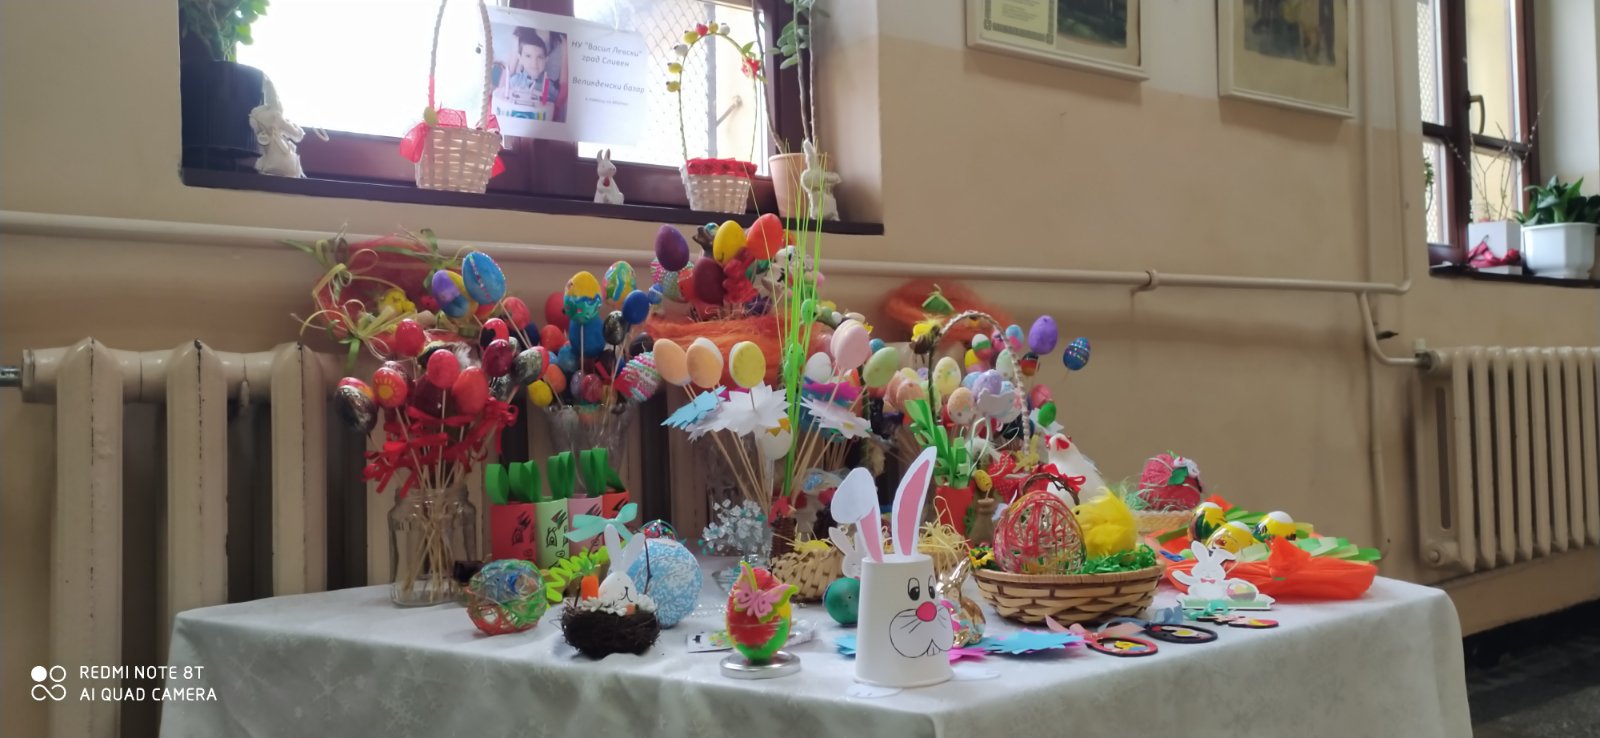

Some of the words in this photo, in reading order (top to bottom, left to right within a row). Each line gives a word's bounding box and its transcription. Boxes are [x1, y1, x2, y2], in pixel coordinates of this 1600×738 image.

[581, 55, 600, 64] град
[602, 57, 630, 67] Сливен
[572, 76, 622, 90] Великденски
[623, 83, 645, 94] базар
